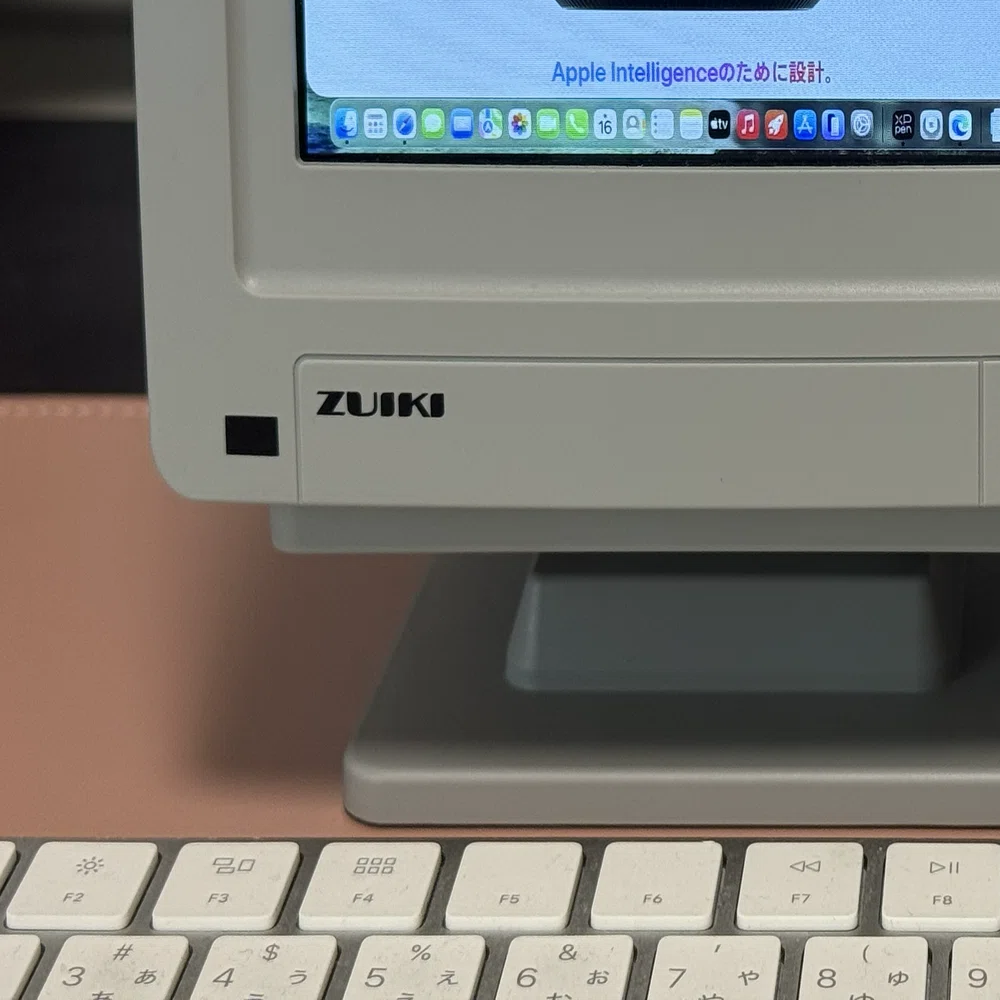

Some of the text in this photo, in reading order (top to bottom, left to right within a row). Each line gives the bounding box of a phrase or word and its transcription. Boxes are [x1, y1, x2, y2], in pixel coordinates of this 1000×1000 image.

[551, 60, 832, 87] Apple Intelligenceのために設計。
[598, 120, 612, 134] 16
[316, 391, 445, 417] ZUIKI
[63, 892, 85, 903] F2
[208, 893, 229, 904] F3
[353, 893, 374, 904] F4
[499, 894, 520, 904] F5
[643, 894, 663, 904] F6
[792, 893, 811, 904] F7
[932, 895, 953, 906] F8
[113, 944, 133, 961] #
[262, 943, 280, 962] $
[411, 944, 431, 961] %
[558, 944, 577, 961] &
[862, 944, 870, 963] (
[62, 966, 86, 987] 3
[134, 968, 157, 985] あ
[212, 967, 235, 987] 4
[289, 969, 308, 985] う
[364, 967, 387, 988] 5
[436, 970, 459, 985] え
[516, 967, 538, 988] 6
[586, 969, 610, 985] お
[668, 968, 687, 989] 7
[738, 969, 760, 986] や
[816, 968, 837, 989] 8
[887, 970, 909, 987] ゆ
[968, 968, 988, 989] 9
